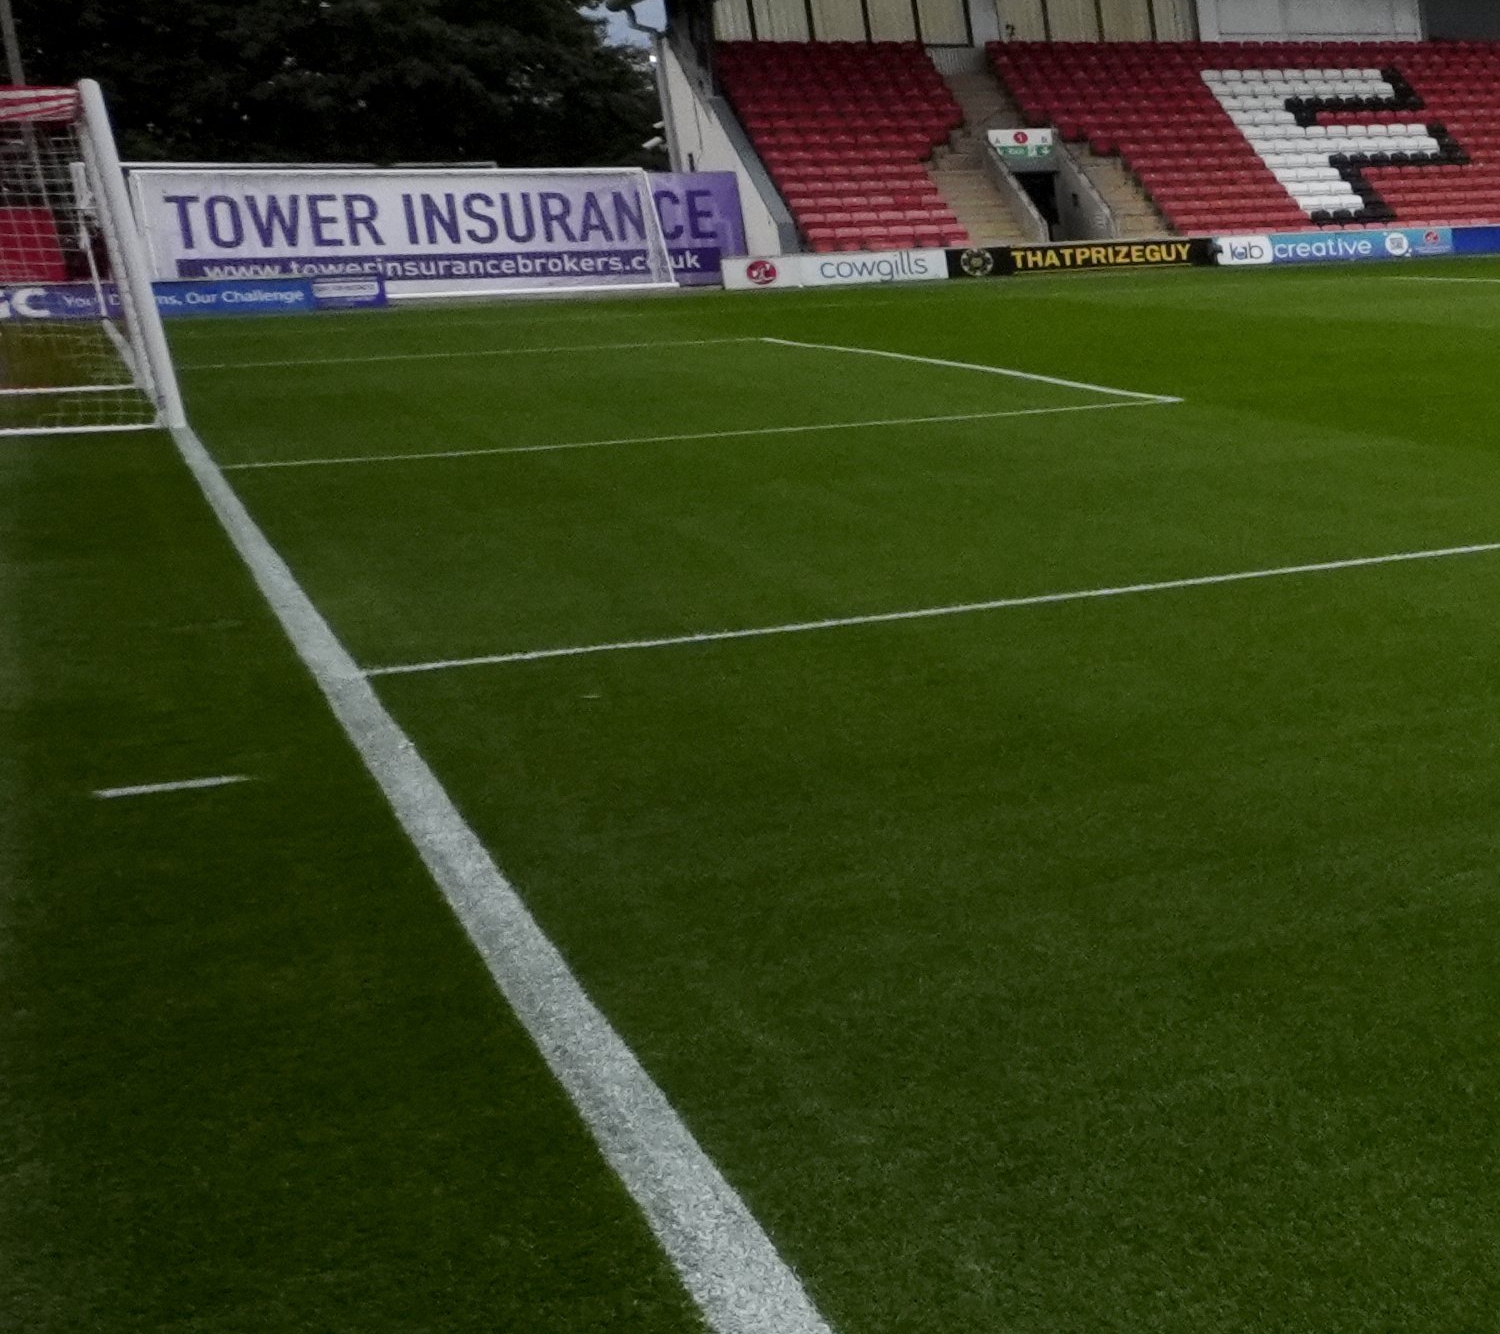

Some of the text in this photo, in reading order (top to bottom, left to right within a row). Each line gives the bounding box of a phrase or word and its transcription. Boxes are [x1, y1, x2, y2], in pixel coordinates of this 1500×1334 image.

[163, 189, 718, 250] TOWER INSURANCE
[1010, 243, 1192, 268] THATPRIZEGUY
[1274, 237, 1373, 259] creative
[203, 249, 701, 279] wwwtowerinsurancebrokers.cuk
[819, 250, 929, 282] cowgills
[186, 291, 218, 306] Our
[220, 288, 305, 304] Challenge
